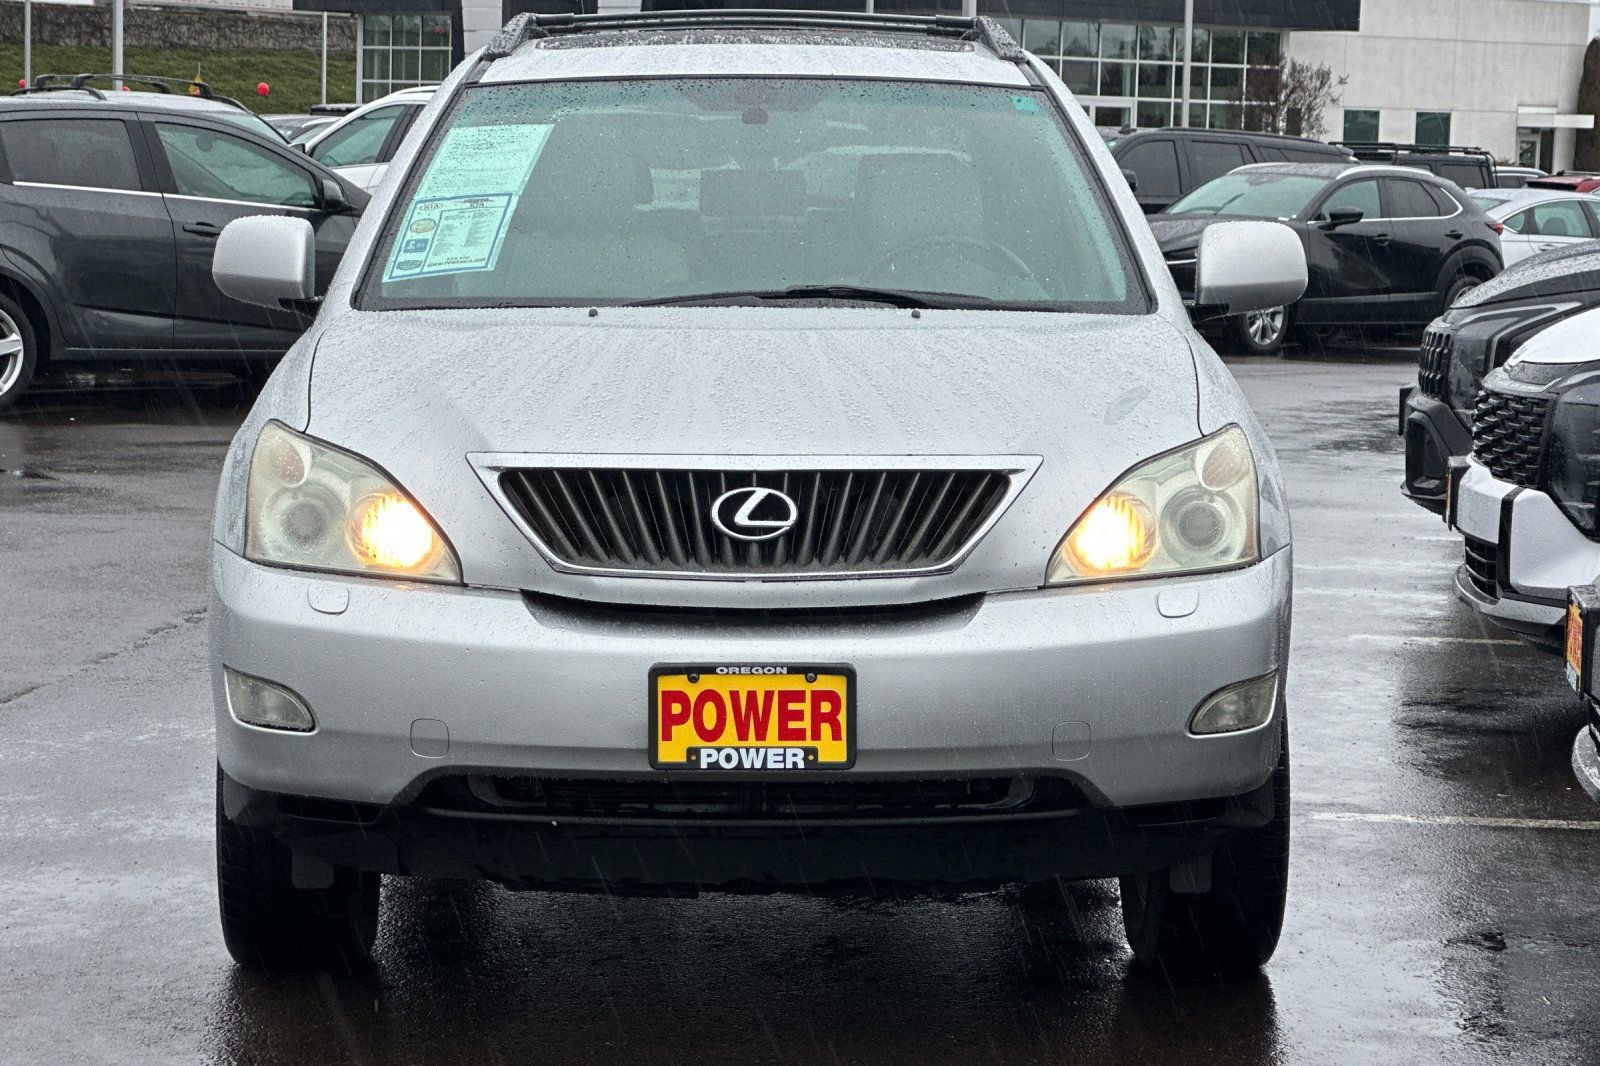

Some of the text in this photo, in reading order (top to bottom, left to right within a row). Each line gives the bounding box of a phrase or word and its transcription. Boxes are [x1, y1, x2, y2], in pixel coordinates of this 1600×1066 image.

[715, 666, 788, 675] OREGON
[661, 688, 843, 743] POWER
[700, 748, 805, 769] POWER
